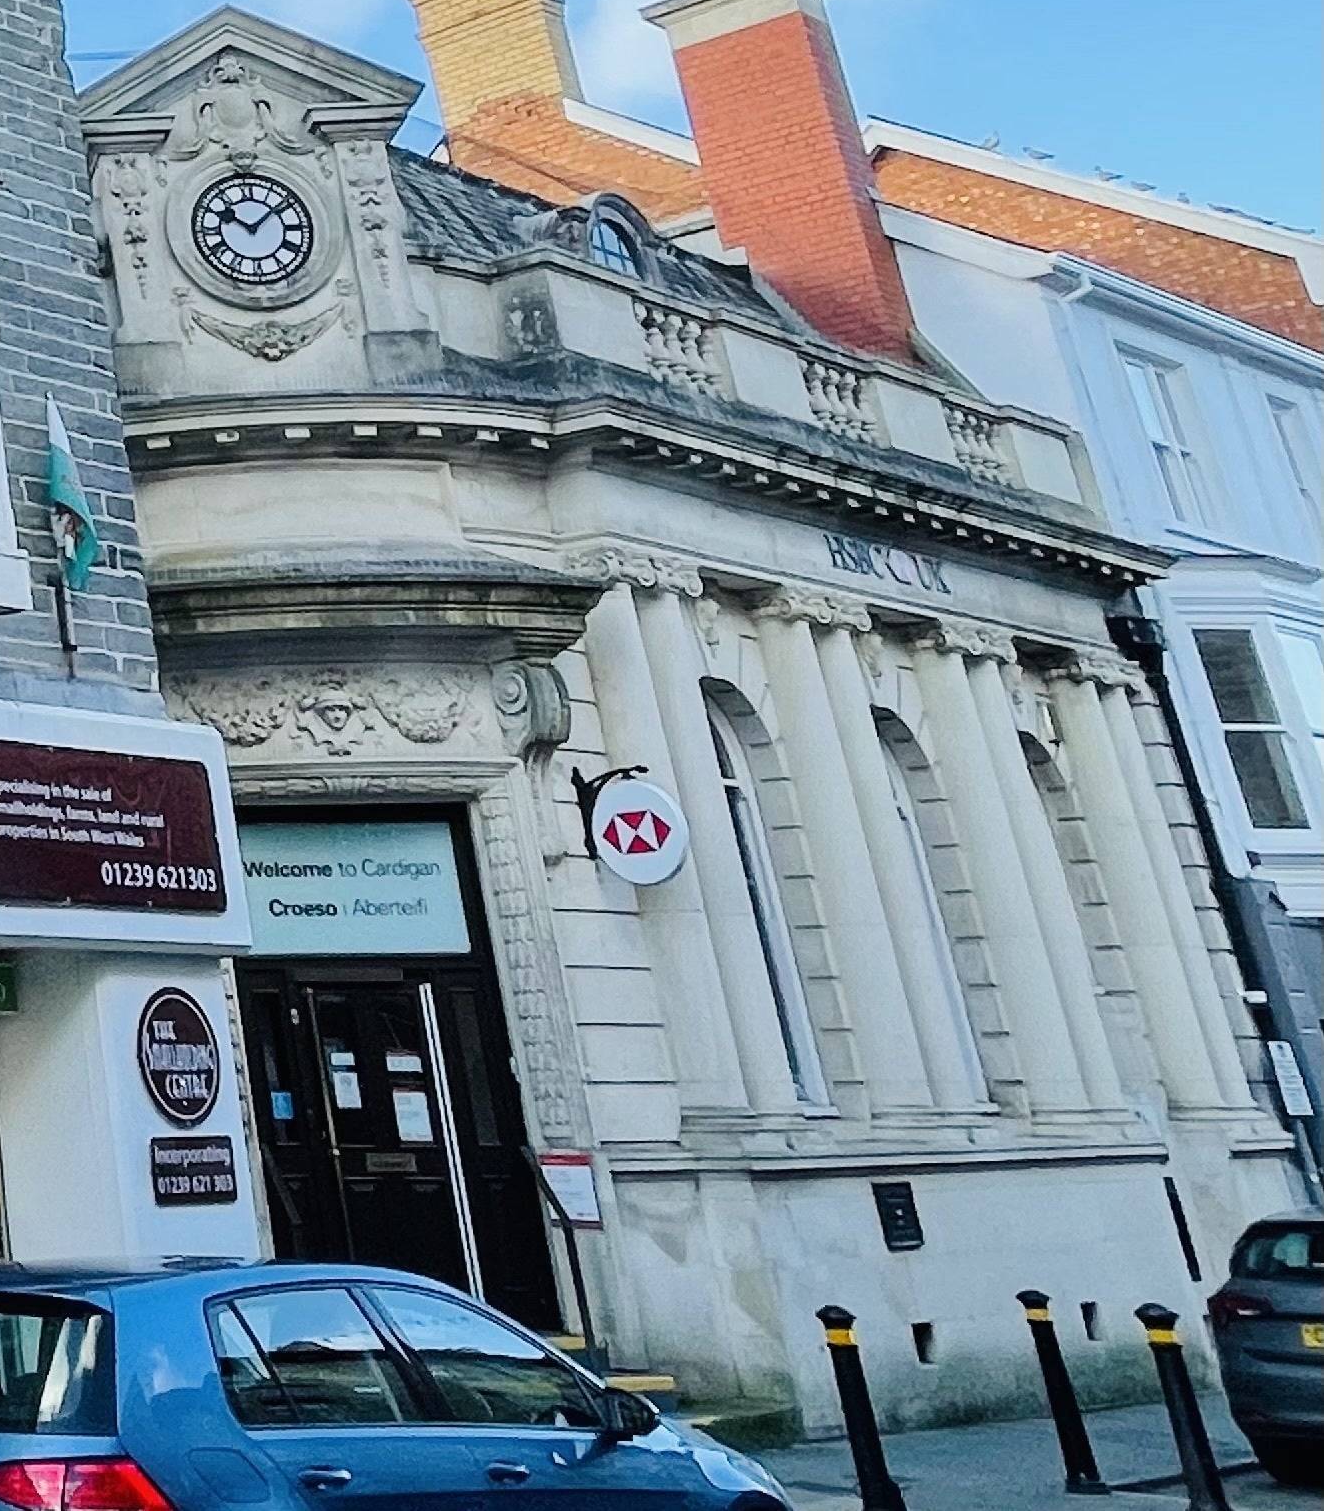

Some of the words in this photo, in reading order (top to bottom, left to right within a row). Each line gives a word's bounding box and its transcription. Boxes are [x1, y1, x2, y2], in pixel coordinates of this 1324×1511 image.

[101, 860, 154, 888] 01239
[157, 865, 218, 892] 621303
[243, 861, 333, 878] Welcome
[338, 862, 357, 878] to
[362, 858, 442, 881] Cardigan
[268, 898, 338, 917] Croeso
